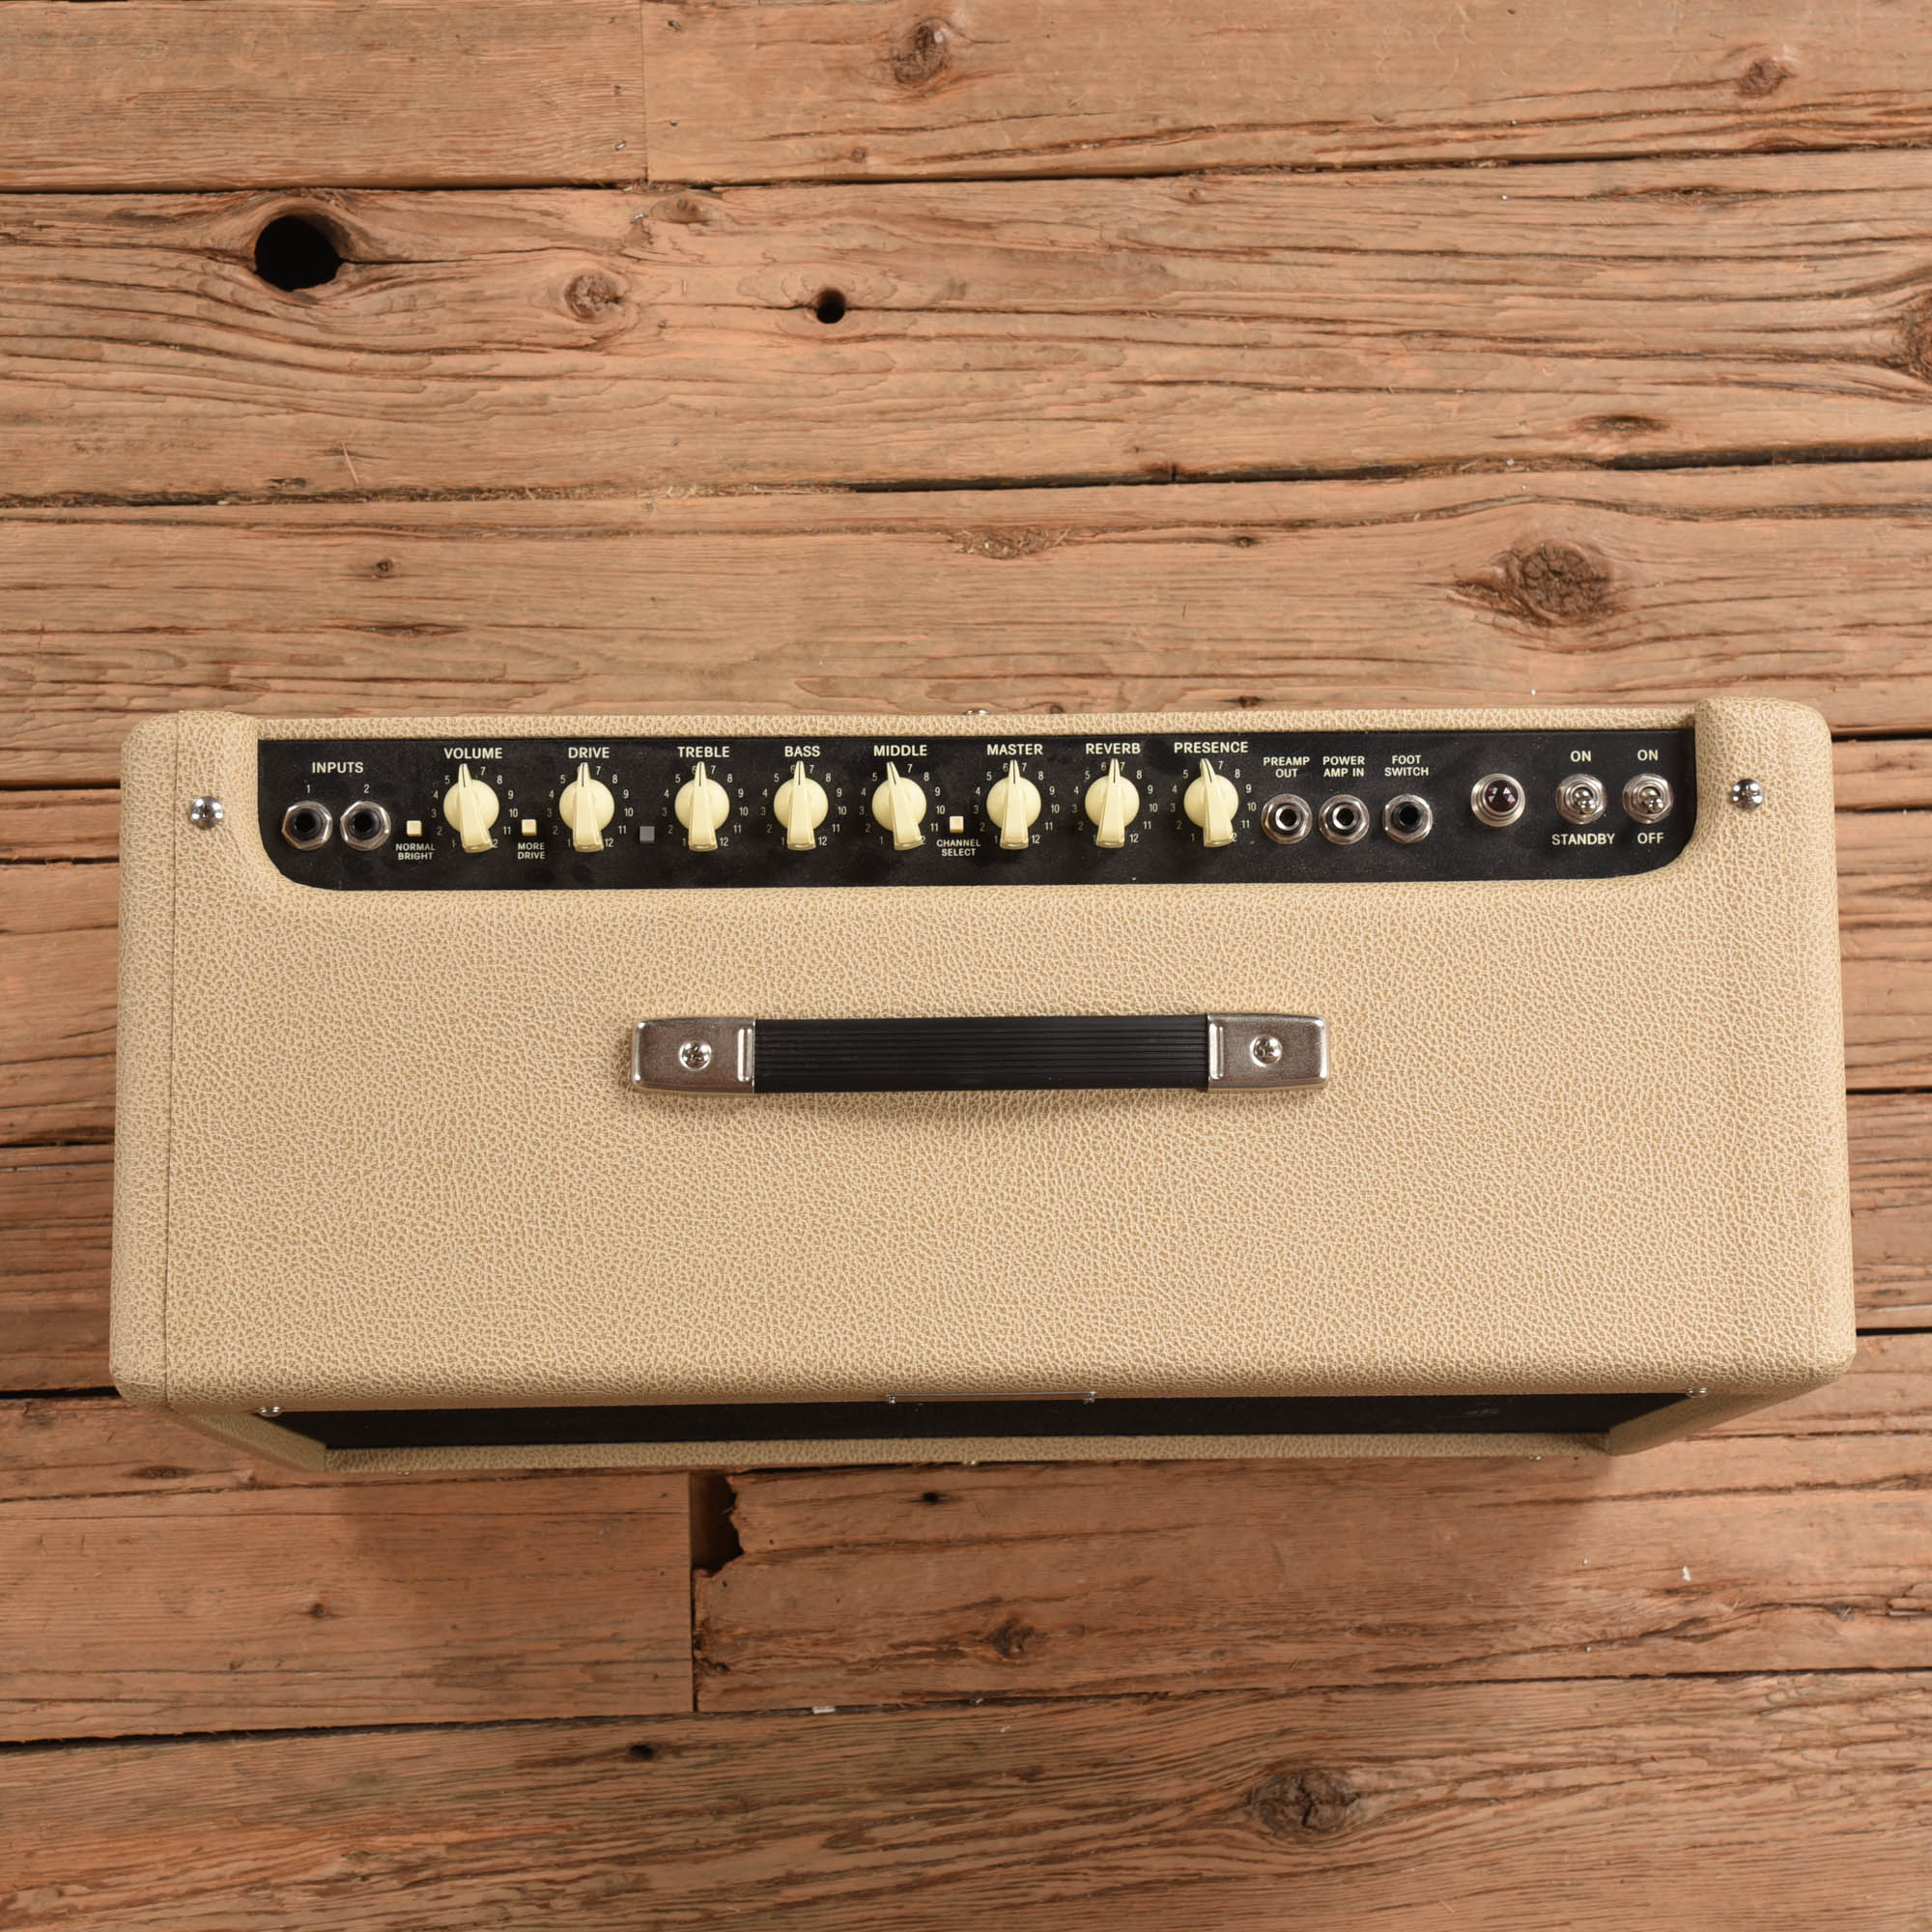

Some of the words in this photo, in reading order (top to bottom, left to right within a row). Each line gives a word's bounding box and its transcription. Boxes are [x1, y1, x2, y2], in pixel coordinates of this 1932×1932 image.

[677, 747, 729, 757] TREBLE
[784, 746, 820, 756] BASS
[874, 745, 927, 756] MIDDLE
[987, 744, 1043, 755] MASTER
[1086, 743, 1140, 754] REVERB
[1175, 742, 1248, 753] PRESENCE
[444, 748, 502, 758] VOLUME
[568, 747, 610, 758] DRIVE
[1571, 751, 1591, 762] ON
[1637, 750, 1658, 761] ON
[1264, 756, 1310, 766] PREAMP
[1323, 756, 1365, 765] POWER
[1392, 755, 1421, 764] FOOT
[312, 762, 363, 773] INPUTS
[711, 765, 716, 774] 7
[908, 764, 913, 773] 7
[1003, 763, 1008, 772] 6
[1101, 762, 1106, 771] 6
[1121, 762, 1125, 771] 7
[1218, 761, 1223, 770] 7
[481, 767, 486, 776] 7
[596, 766, 601, 775] 7
[1137, 770, 1142, 779] 8
[1183, 770, 1188, 779] 5
[1235, 769, 1240, 778] 8
[1276, 769, 1297, 778] OUT
[1323, 768, 1348, 777] AMP
[1352, 768, 1364, 777] IN
[1384, 767, 1429, 777] SWITCH
[445, 776, 450, 784] 5
[497, 775, 502, 784] 8
[560, 775, 565, 783] 5
[612, 774, 617, 783] 8
[675, 774, 680, 782] 5
[727, 774, 732, 782] 8
[774, 774, 779, 782] 5
[826, 773, 831, 781] 8
[872, 773, 877, 781] 5
[924, 772, 929, 781] 8
[986, 772, 992, 781] 5
[1038, 771, 1043, 780] 8
[1085, 771, 1090, 780] 5
[307, 784, 310, 793] 1
[363, 784, 369, 793] 2
[738, 788, 744, 798] 9
[762, 788, 767, 797] 4
[837, 788, 842, 797] 9
[935, 787, 940, 796] 9
[1049, 786, 1055, 795] 9
[1148, 785, 1153, 794] 9
[1246, 784, 1251, 793] 9
[433, 790, 438, 800] 4
[508, 790, 514, 799] 9
[549, 790, 554, 799] 4
[623, 789, 629, 799] 9
[665, 789, 669, 798] 4
[739, 807, 749, 815] 10
[760, 807, 766, 815] 3
[838, 806, 846, 815] 10
[859, 806, 865, 815] 3
[936, 805, 945, 814] 10
[1051, 804, 1060, 813] 10
[1072, 804, 1077, 812] 3
[1150, 804, 1157, 812] 10
[1247, 803, 1256, 811] 10
[431, 810, 437, 818] 3
[509, 809, 518, 817] 10
[547, 809, 552, 817] 3
[624, 808, 634, 816] 10
[662, 808, 668, 816] 3
[832, 824, 839, 833] 11
[866, 824, 870, 833] 2
[930, 823, 938, 832] 11
[980, 822, 985, 831] 2
[1078, 821, 1083, 830] 2
[1144, 821, 1151, 830] 11
[1177, 821, 1181, 830] 2
[1241, 820, 1249, 829] 11
[438, 827, 442, 836] 2
[553, 826, 557, 835] 2
[668, 825, 673, 834] 2
[605, 838, 613, 847] 12
[720, 838, 728, 846] 12
[818, 837, 827, 845] 12
[1032, 835, 1040, 843] 12
[1129, 834, 1139, 842] 12
[1551, 834, 1615, 845] STANDBY
[1637, 833, 1664, 844] OFF
